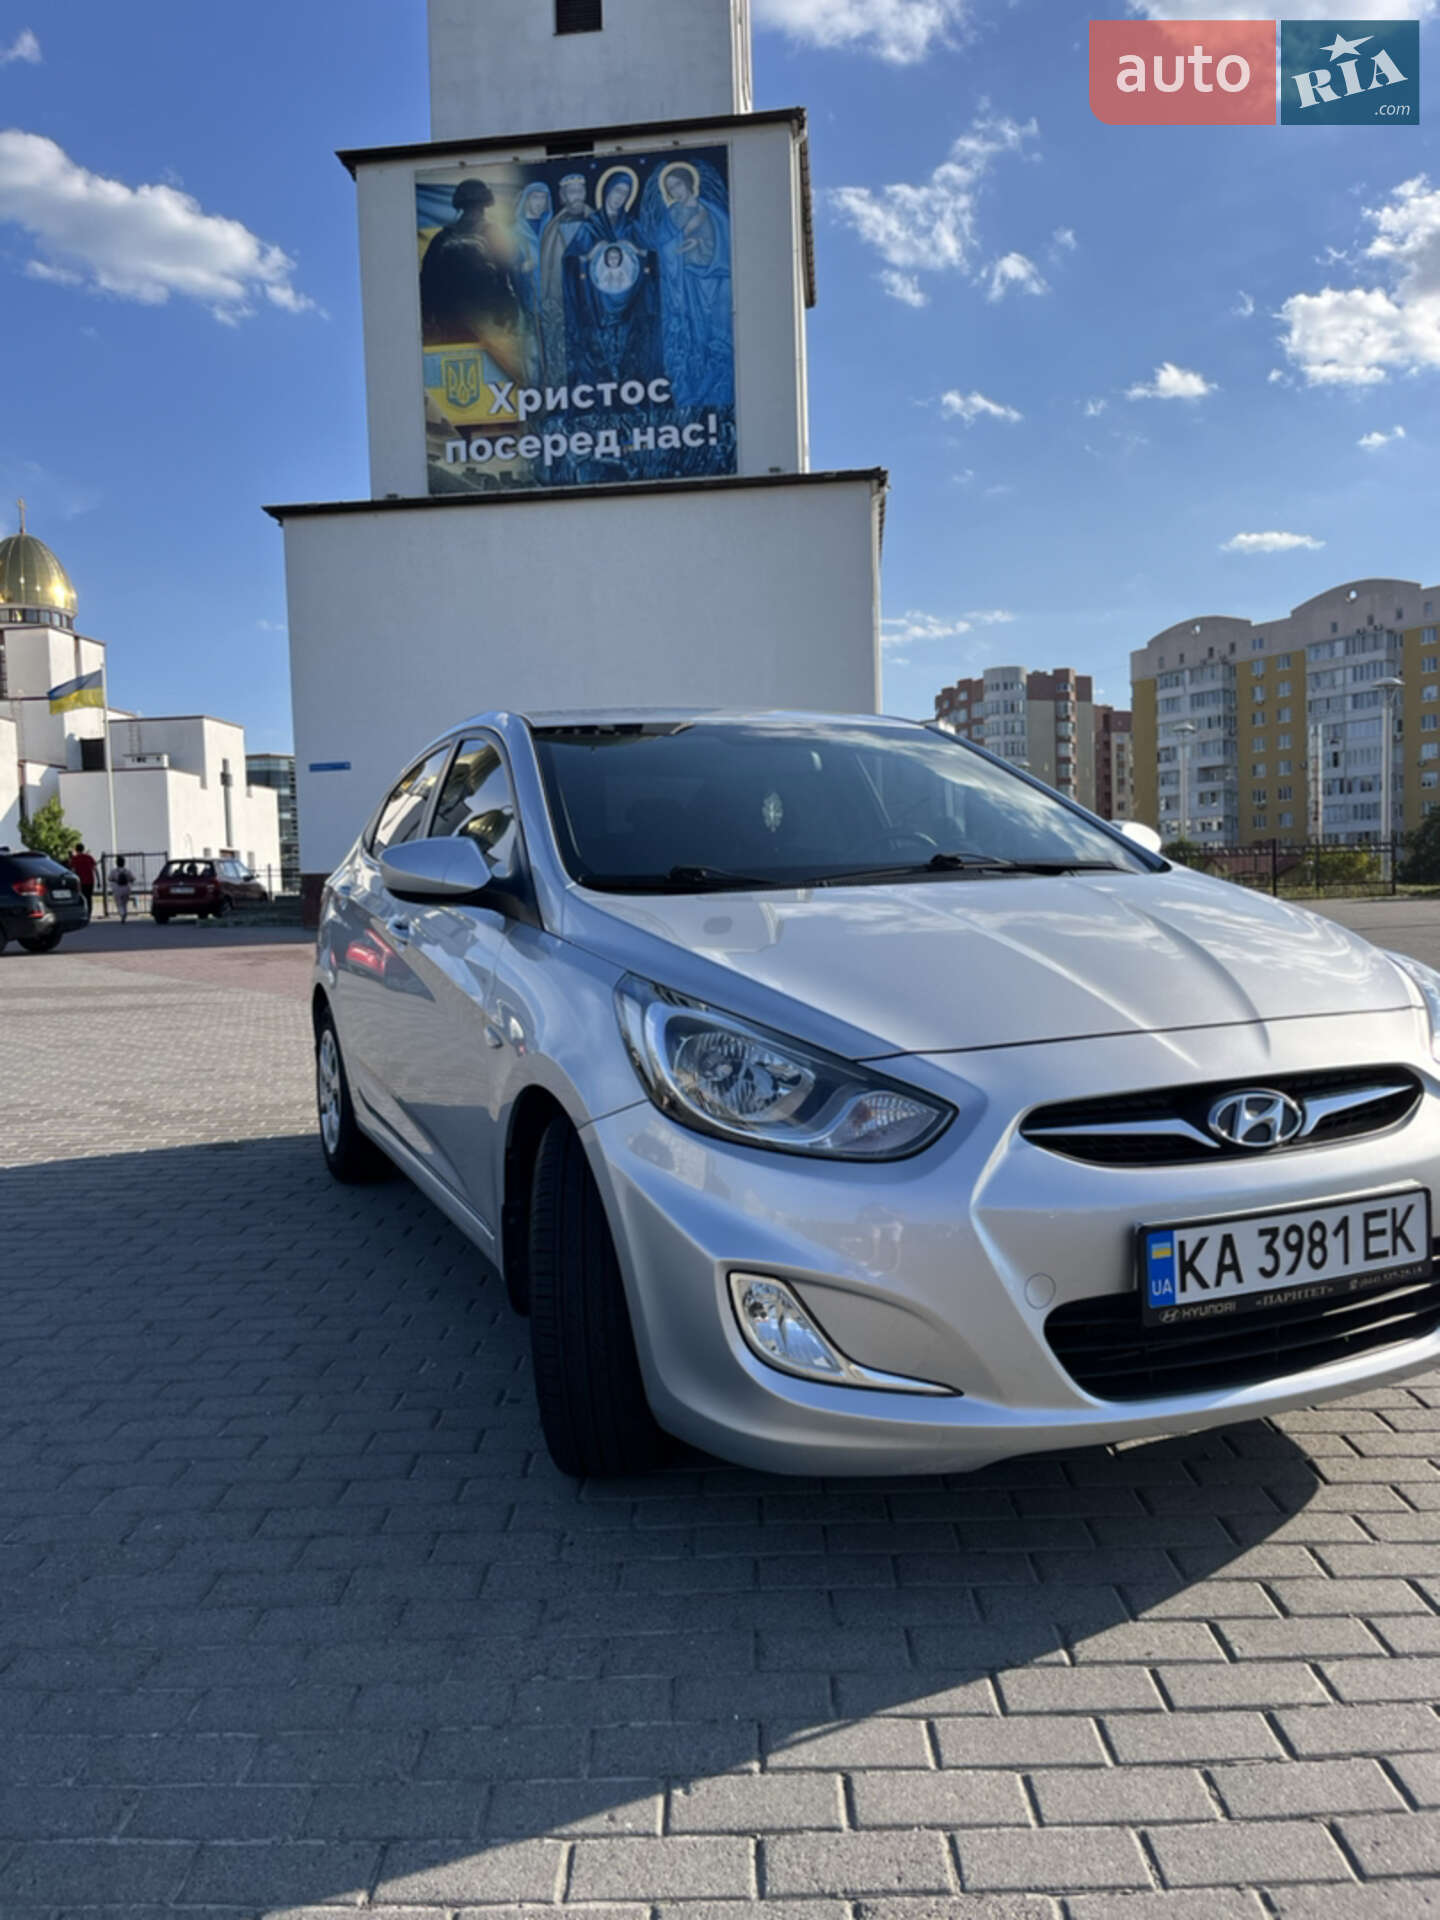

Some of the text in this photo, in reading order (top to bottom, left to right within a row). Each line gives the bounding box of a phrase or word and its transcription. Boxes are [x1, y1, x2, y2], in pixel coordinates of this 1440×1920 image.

[488, 377, 671, 421] Христос
[445, 413, 718, 466] посеред нас!
[1178, 1234, 1244, 1293] KA
[1257, 1215, 1350, 1279] 3981
[1363, 1204, 1416, 1262] EK
[1152, 1278, 1173, 1296] UA
[1181, 1301, 1237, 1320] HYUNDAI
